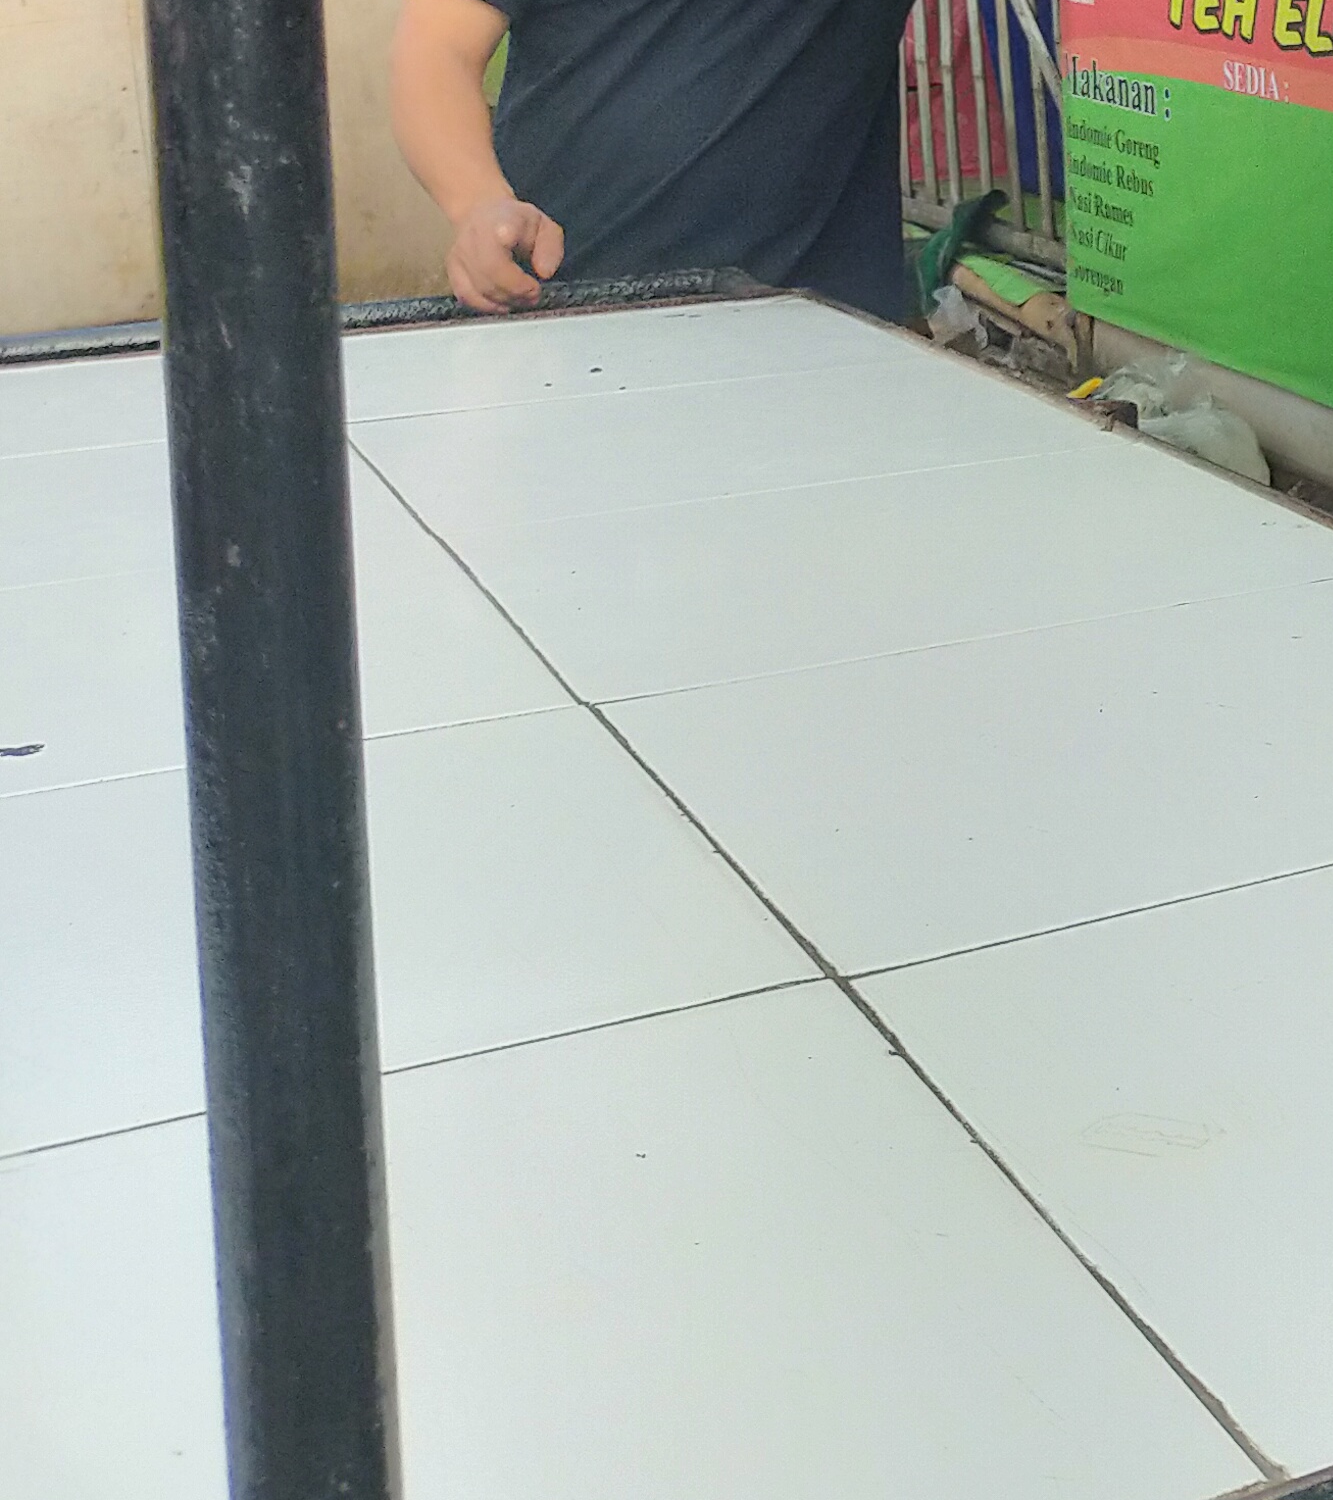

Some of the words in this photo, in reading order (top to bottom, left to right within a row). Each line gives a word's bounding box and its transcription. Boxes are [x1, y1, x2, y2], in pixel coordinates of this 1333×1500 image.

[1222, 59, 1280, 99] SEDIA
[1115, 128, 1160, 169] Goreng
[1116, 165, 1154, 197] Rebus
[1095, 193, 1133, 227] Rames
